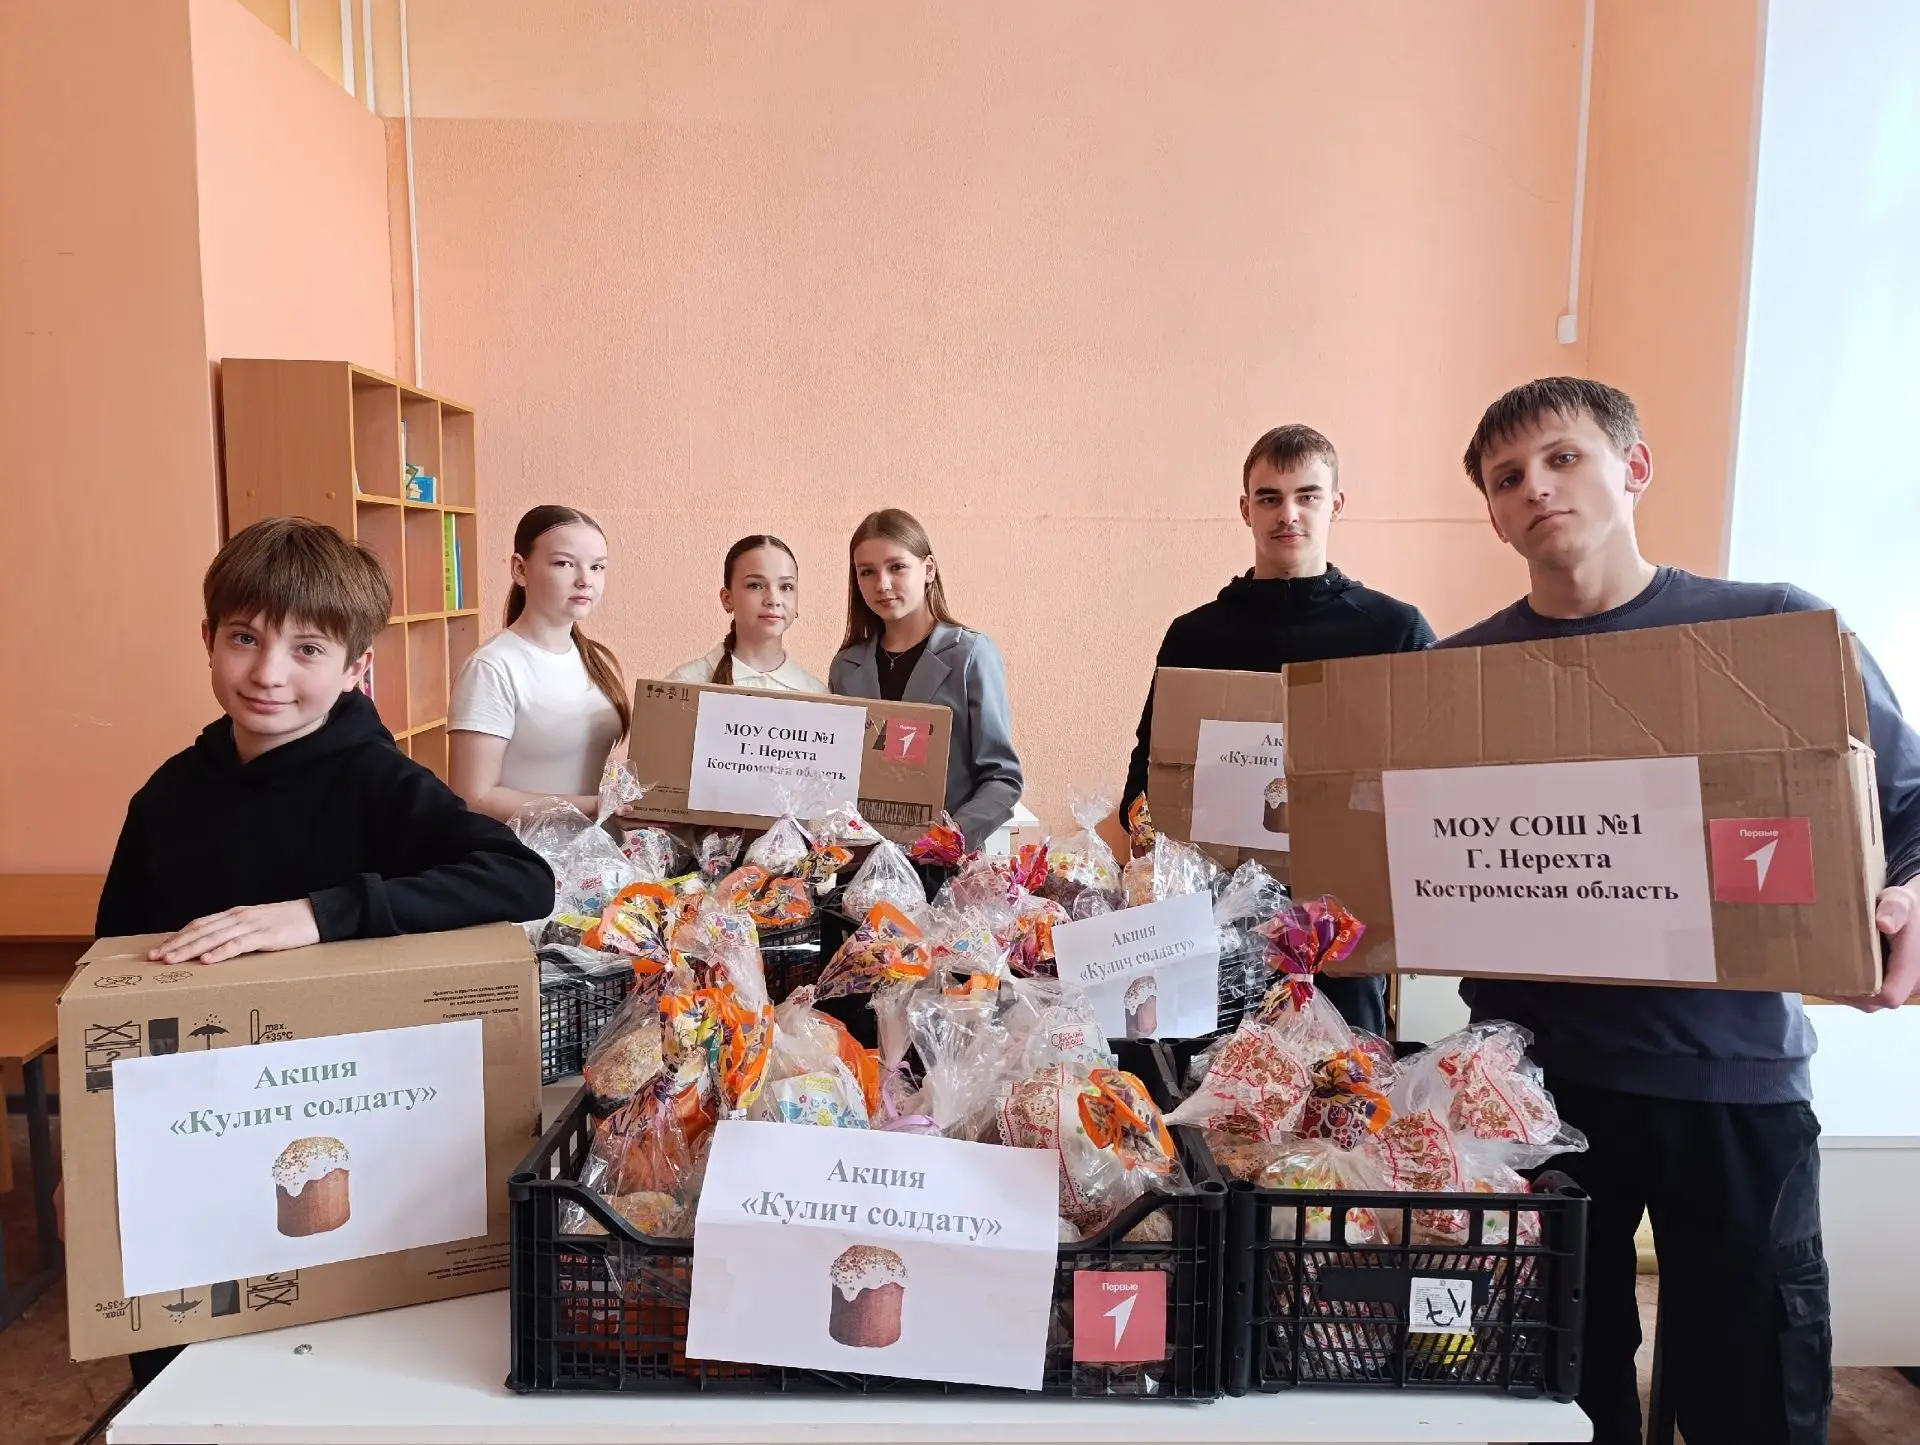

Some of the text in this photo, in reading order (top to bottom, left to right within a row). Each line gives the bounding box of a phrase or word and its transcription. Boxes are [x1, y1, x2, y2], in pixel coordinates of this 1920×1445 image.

[724, 723, 835, 745] МОУ СОШ №1
[740, 742, 817, 761] Г. Нерехта
[1219, 750, 1279, 767] «Кулич
[1432, 813, 1643, 838] МОУ СОШ №1
[1739, 828, 1779, 839] Первые
[1466, 848, 1612, 874] Г. Нерехта
[1414, 878, 1680, 902] Костромская область
[1111, 925, 1157, 948] Акция
[1079, 939, 1196, 982] «Кулич солдату»
[265, 1022, 288, 1031] max.
[253, 1060, 358, 1090] Акция
[169, 1085, 438, 1137] «Кулич солдату»
[826, 1158, 926, 1189] Акция
[740, 1190, 1003, 1241] «Кулич солдату»
[1102, 1282, 1139, 1293] Первые
